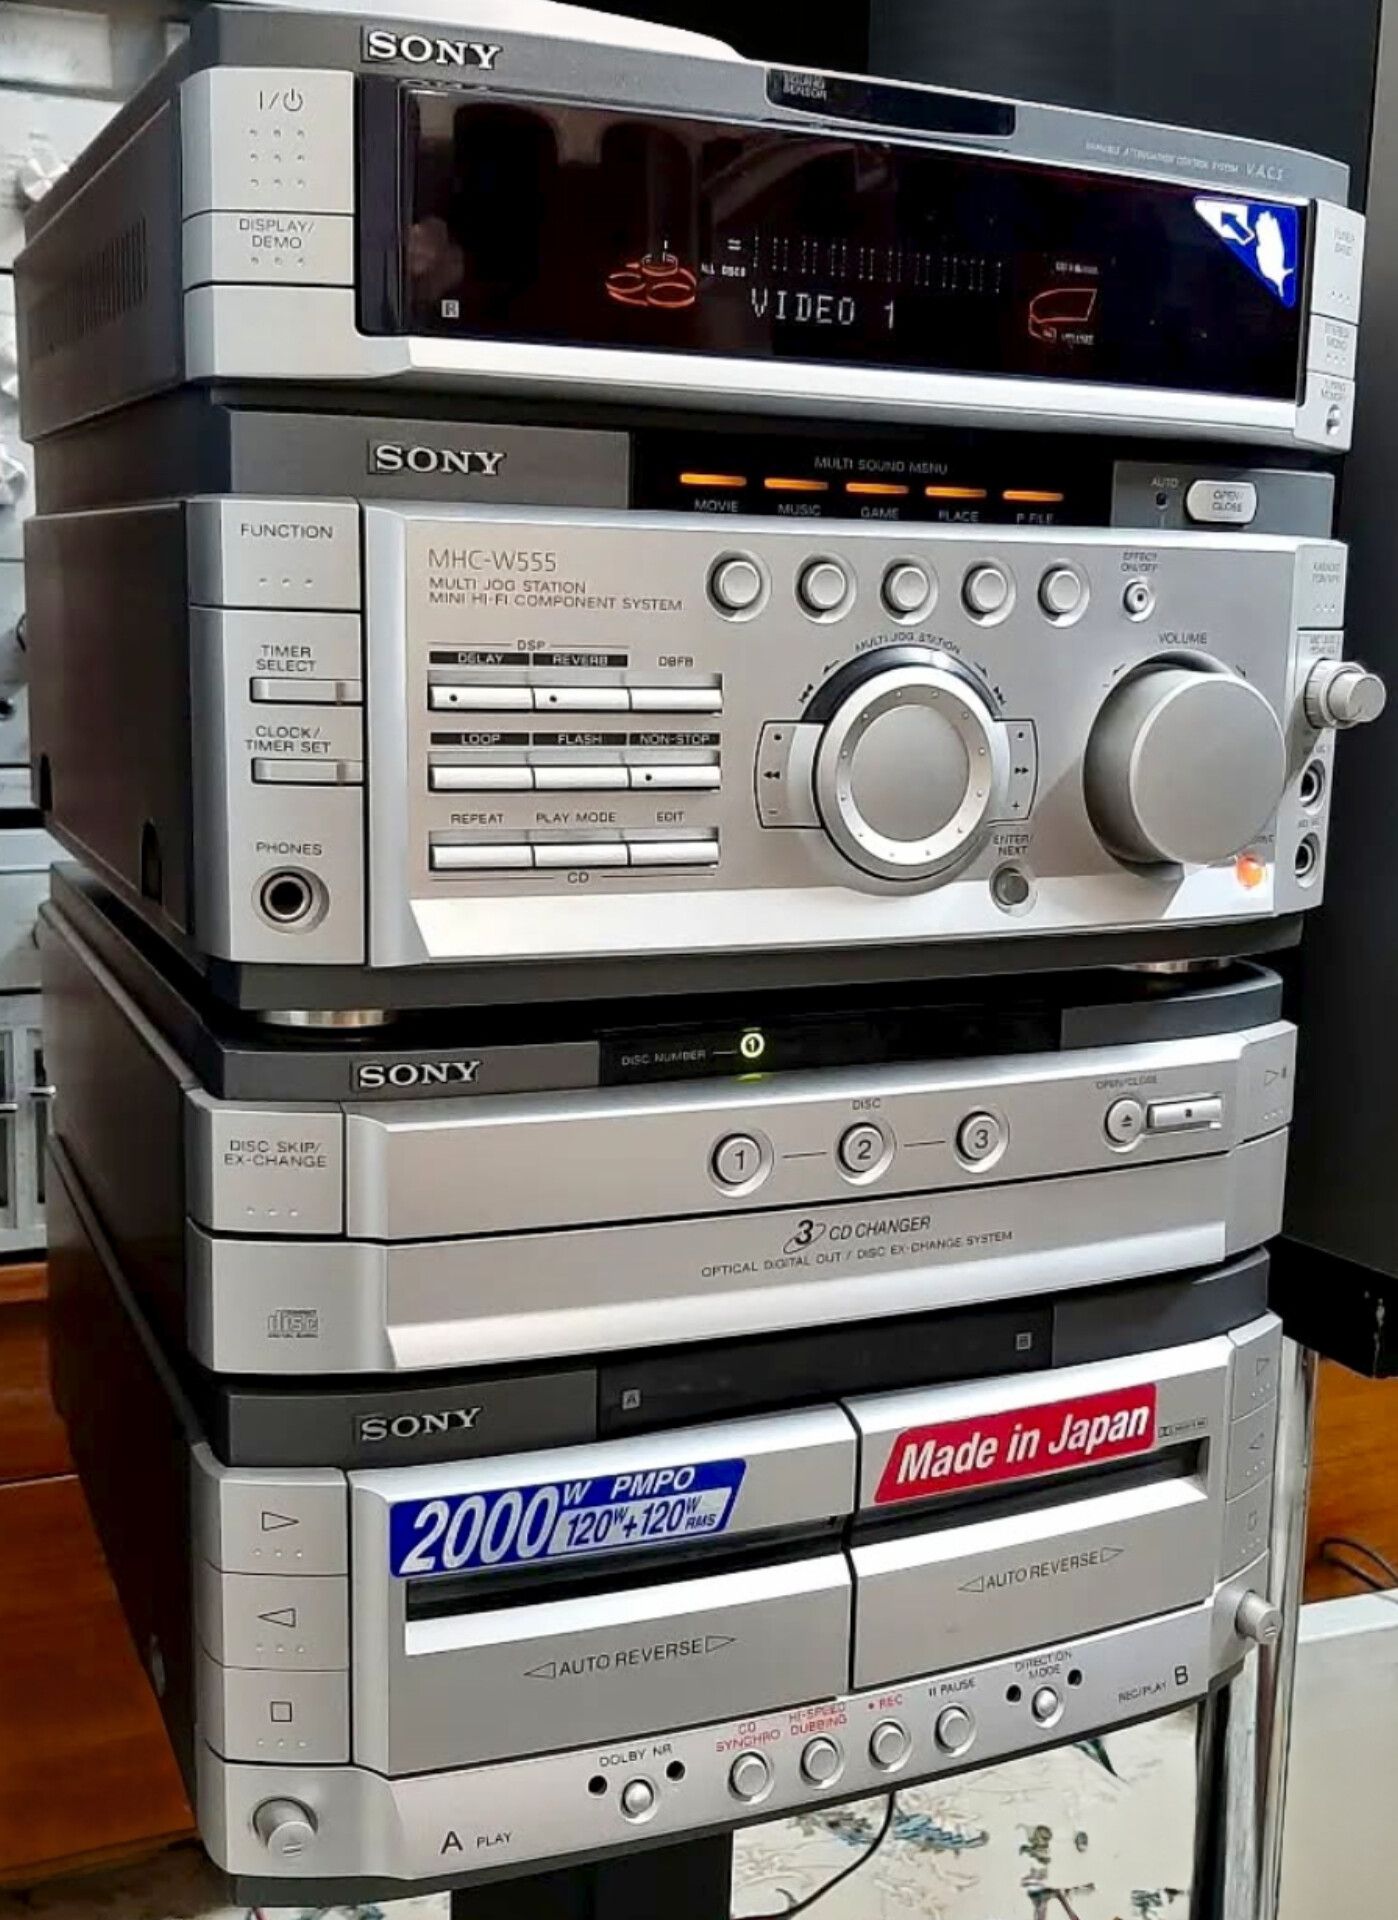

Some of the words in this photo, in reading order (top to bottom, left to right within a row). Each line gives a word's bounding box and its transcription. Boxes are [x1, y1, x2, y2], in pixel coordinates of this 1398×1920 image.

[369, 31, 500, 69] SONY
[240, 219, 314, 234] DISPLAY/
[252, 235, 302, 249] DEMO
[751, 288, 855, 326] VIDEO
[884, 299, 894, 330] 1
[375, 445, 504, 475] SONY
[814, 457, 853, 471] MULTI
[858, 459, 905, 474] SOUND
[909, 461, 948, 476] MENU
[1151, 477, 1179, 488] AUTO
[694, 498, 739, 514] MOVIE
[778, 503, 821, 517] MUSIC
[861, 507, 899, 521] GAME
[939, 510, 979, 523] PLACE
[241, 522, 333, 540] FUNCTION
[428, 547, 558, 573] MHC-W555
[429, 577, 477, 591] MULTI
[484, 579, 516, 593] JOG
[523, 580, 586, 595] STATION
[429, 592, 467, 606] MINI
[471, 593, 509, 607] HI-FI
[514, 594, 617, 610] COMPONENT
[623, 597, 684, 611] SYSTEM
[517, 640, 545, 652] DSP
[1158, 631, 1208, 645] VOLUME
[261, 645, 311, 659] TIMER
[457, 653, 503, 665] DELAY
[553, 655, 608, 668] REVERB
[256, 658, 317, 673] SELECT
[255, 725, 321, 739] CLOCK/
[461, 734, 500, 746] LOOP
[557, 734, 603, 746] FLASH
[640, 734, 710, 746] NON-STOP
[245, 739, 295, 753] TIMER
[300, 741, 331, 755] SET
[450, 813, 504, 825] REPEAT
[536, 812, 571, 824] PLAY
[576, 811, 616, 823] MODE
[656, 810, 684, 823] EDIT
[256, 841, 322, 856] PHONES
[998, 846, 1027, 856] NEXT
[567, 872, 589, 884] CD
[621, 1053, 650, 1066] DISC
[654, 1049, 706, 1063] NUMBER
[359, 1060, 481, 1088] SONY
[852, 1098, 881, 1110] DISC
[229, 1139, 269, 1154] DISC
[277, 1140, 322, 1154] SKIP/
[734, 1149, 745, 1171] 1
[856, 1139, 872, 1160] 2
[974, 1129, 989, 1147] 3
[224, 1153, 327, 1168] EX-CHANGE
[794, 1219, 815, 1246] 3
[829, 1224, 853, 1241] CD
[855, 1216, 931, 1240] CHANGER
[701, 1261, 758, 1278] OPTICAL
[763, 1255, 809, 1272] DIGITAL
[816, 1250, 842, 1264] OUT
[857, 1246, 885, 1260] DISC
[890, 1236, 962, 1256] EX-CHANGE
[967, 1230, 1013, 1246] SYSTEM
[361, 1407, 481, 1441] SONY
[897, 1435, 998, 1485] Made
[1006, 1423, 1037, 1464] in
[1048, 1406, 1150, 1455] Japan
[611, 1466, 695, 1501] PMPO
[685, 1514, 716, 1531] RMS
[985, 1567, 1027, 1590] AUTO
[1030, 1551, 1098, 1580] REVERSE
[559, 1654, 609, 1677] AUTO
[616, 1638, 704, 1668] REVERSE
[1028, 1663, 1061, 1680] MODE
[941, 1679, 977, 1697] PAUSE
[1118, 1681, 1167, 1704] REC/PLAY
[1175, 1665, 1189, 1687] B
[879, 1694, 904, 1710] REC
[788, 1702, 847, 1722] HI-SPEED
[738, 1721, 757, 1735] CD
[790, 1714, 848, 1736] DUBBING
[716, 1728, 781, 1752] SYNCHRO
[600, 1747, 647, 1768] DOLBY
[652, 1743, 673, 1758] NR
[440, 1831, 464, 1854] A
[476, 1831, 513, 1848] PLAY
